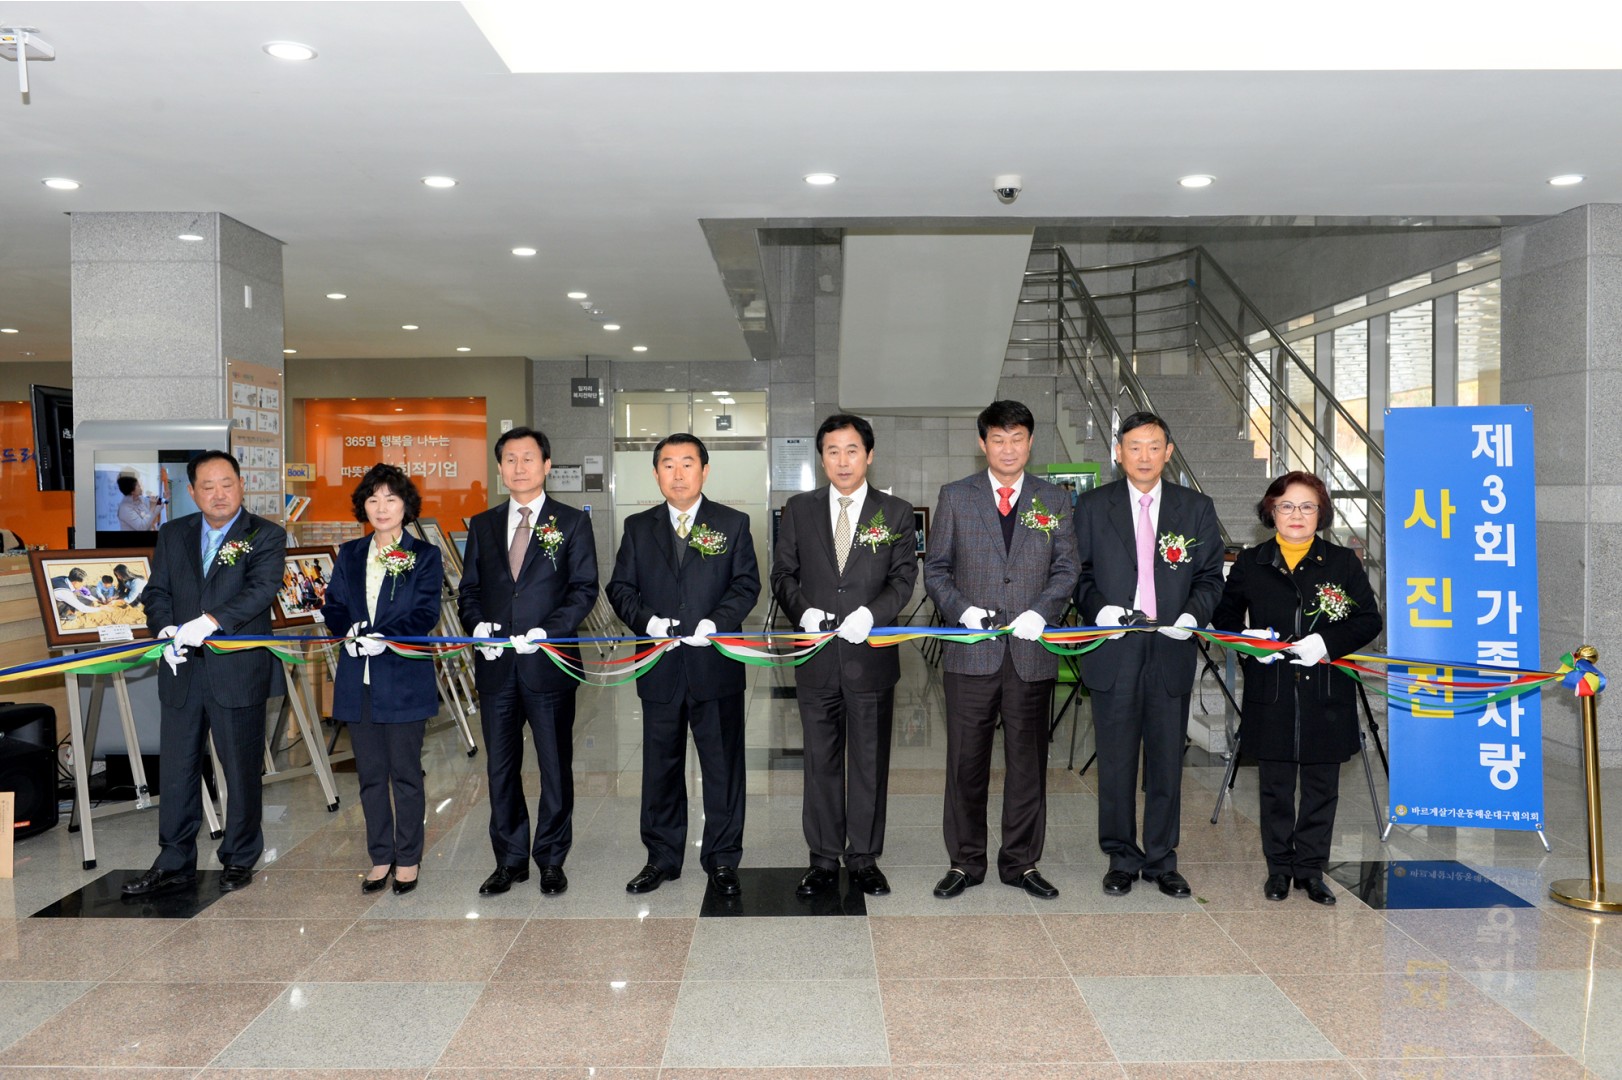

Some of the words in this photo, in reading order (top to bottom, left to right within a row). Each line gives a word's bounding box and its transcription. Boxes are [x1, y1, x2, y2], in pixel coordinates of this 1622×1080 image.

[288, 468, 305, 477] Book
[345, 435, 376, 447] 365일
[380, 435, 413, 447] 행복을
[417, 435, 450, 447] 나누는
[384, 461, 458, 478] 회적기업
[1472, 424, 1516, 567] 제3회
[1404, 489, 1456, 718] 사진전
[1477, 590, 1526, 790] 가족사랑
